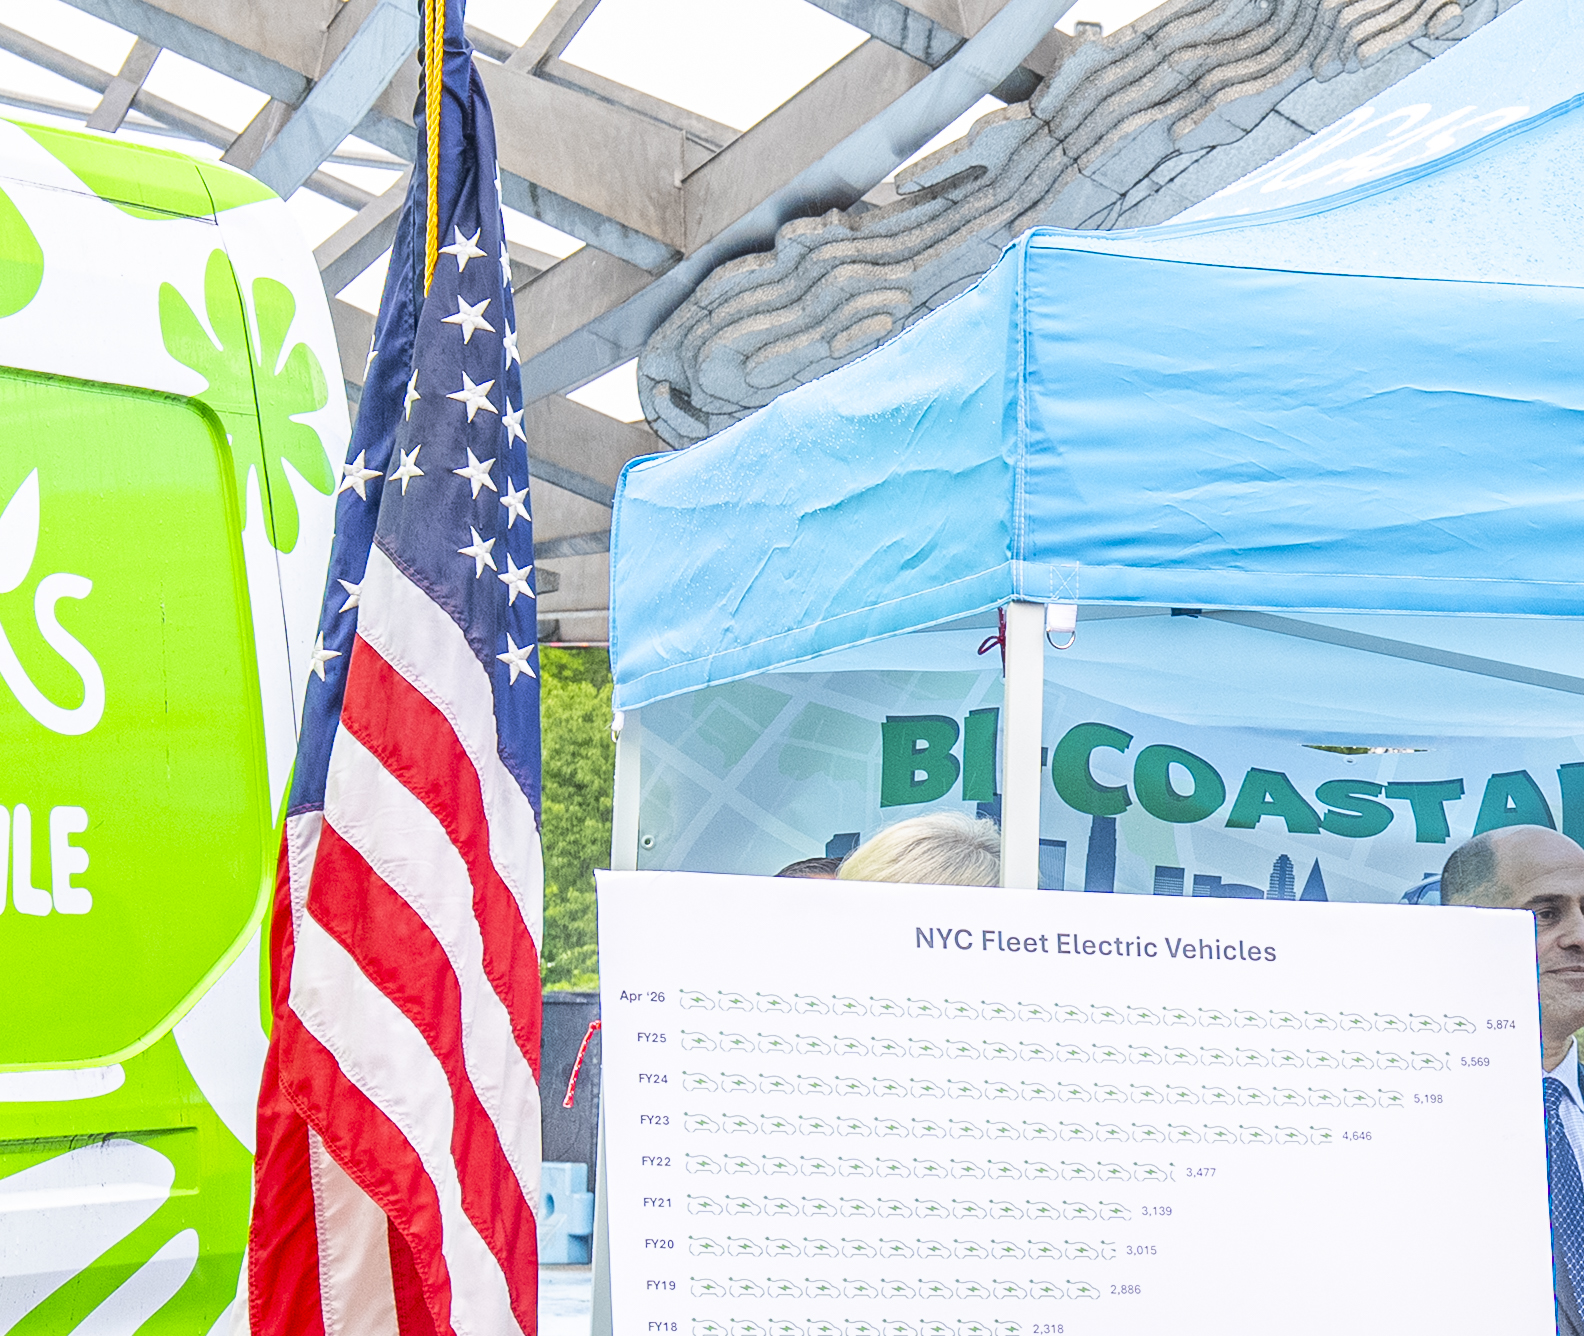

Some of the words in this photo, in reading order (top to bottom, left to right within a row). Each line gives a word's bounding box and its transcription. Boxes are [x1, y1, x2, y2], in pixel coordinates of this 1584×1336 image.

[916, 927, 972, 950] NYC
[983, 930, 1048, 953] Fleet
[1057, 933, 1157, 957] Electric
[1165, 938, 1276, 961] Vehicles
[620, 990, 642, 1003] Apr
[1487, 1020, 1515, 1030] 5,874
[638, 1032, 666, 1042] FY25
[1461, 1057, 1490, 1067] 5,569
[639, 1074, 667, 1083] FY24
[1414, 1094, 1443, 1104] 5,198
[641, 1115, 669, 1125] FY23
[1343, 1131, 1372, 1141] 4,646
[642, 1156, 671, 1166] FY22
[1187, 1168, 1216, 1177] 3,477
[644, 1198, 671, 1207] FY21
[1142, 1206, 1172, 1216] 3,139
[645, 1239, 674, 1249] FY20
[1127, 1245, 1157, 1255] 3,015
[647, 1280, 675, 1290] FY19
[1111, 1285, 1141, 1295] 2,886
[649, 1322, 677, 1331] FY18
[1033, 1324, 1064, 1335] 2,318
